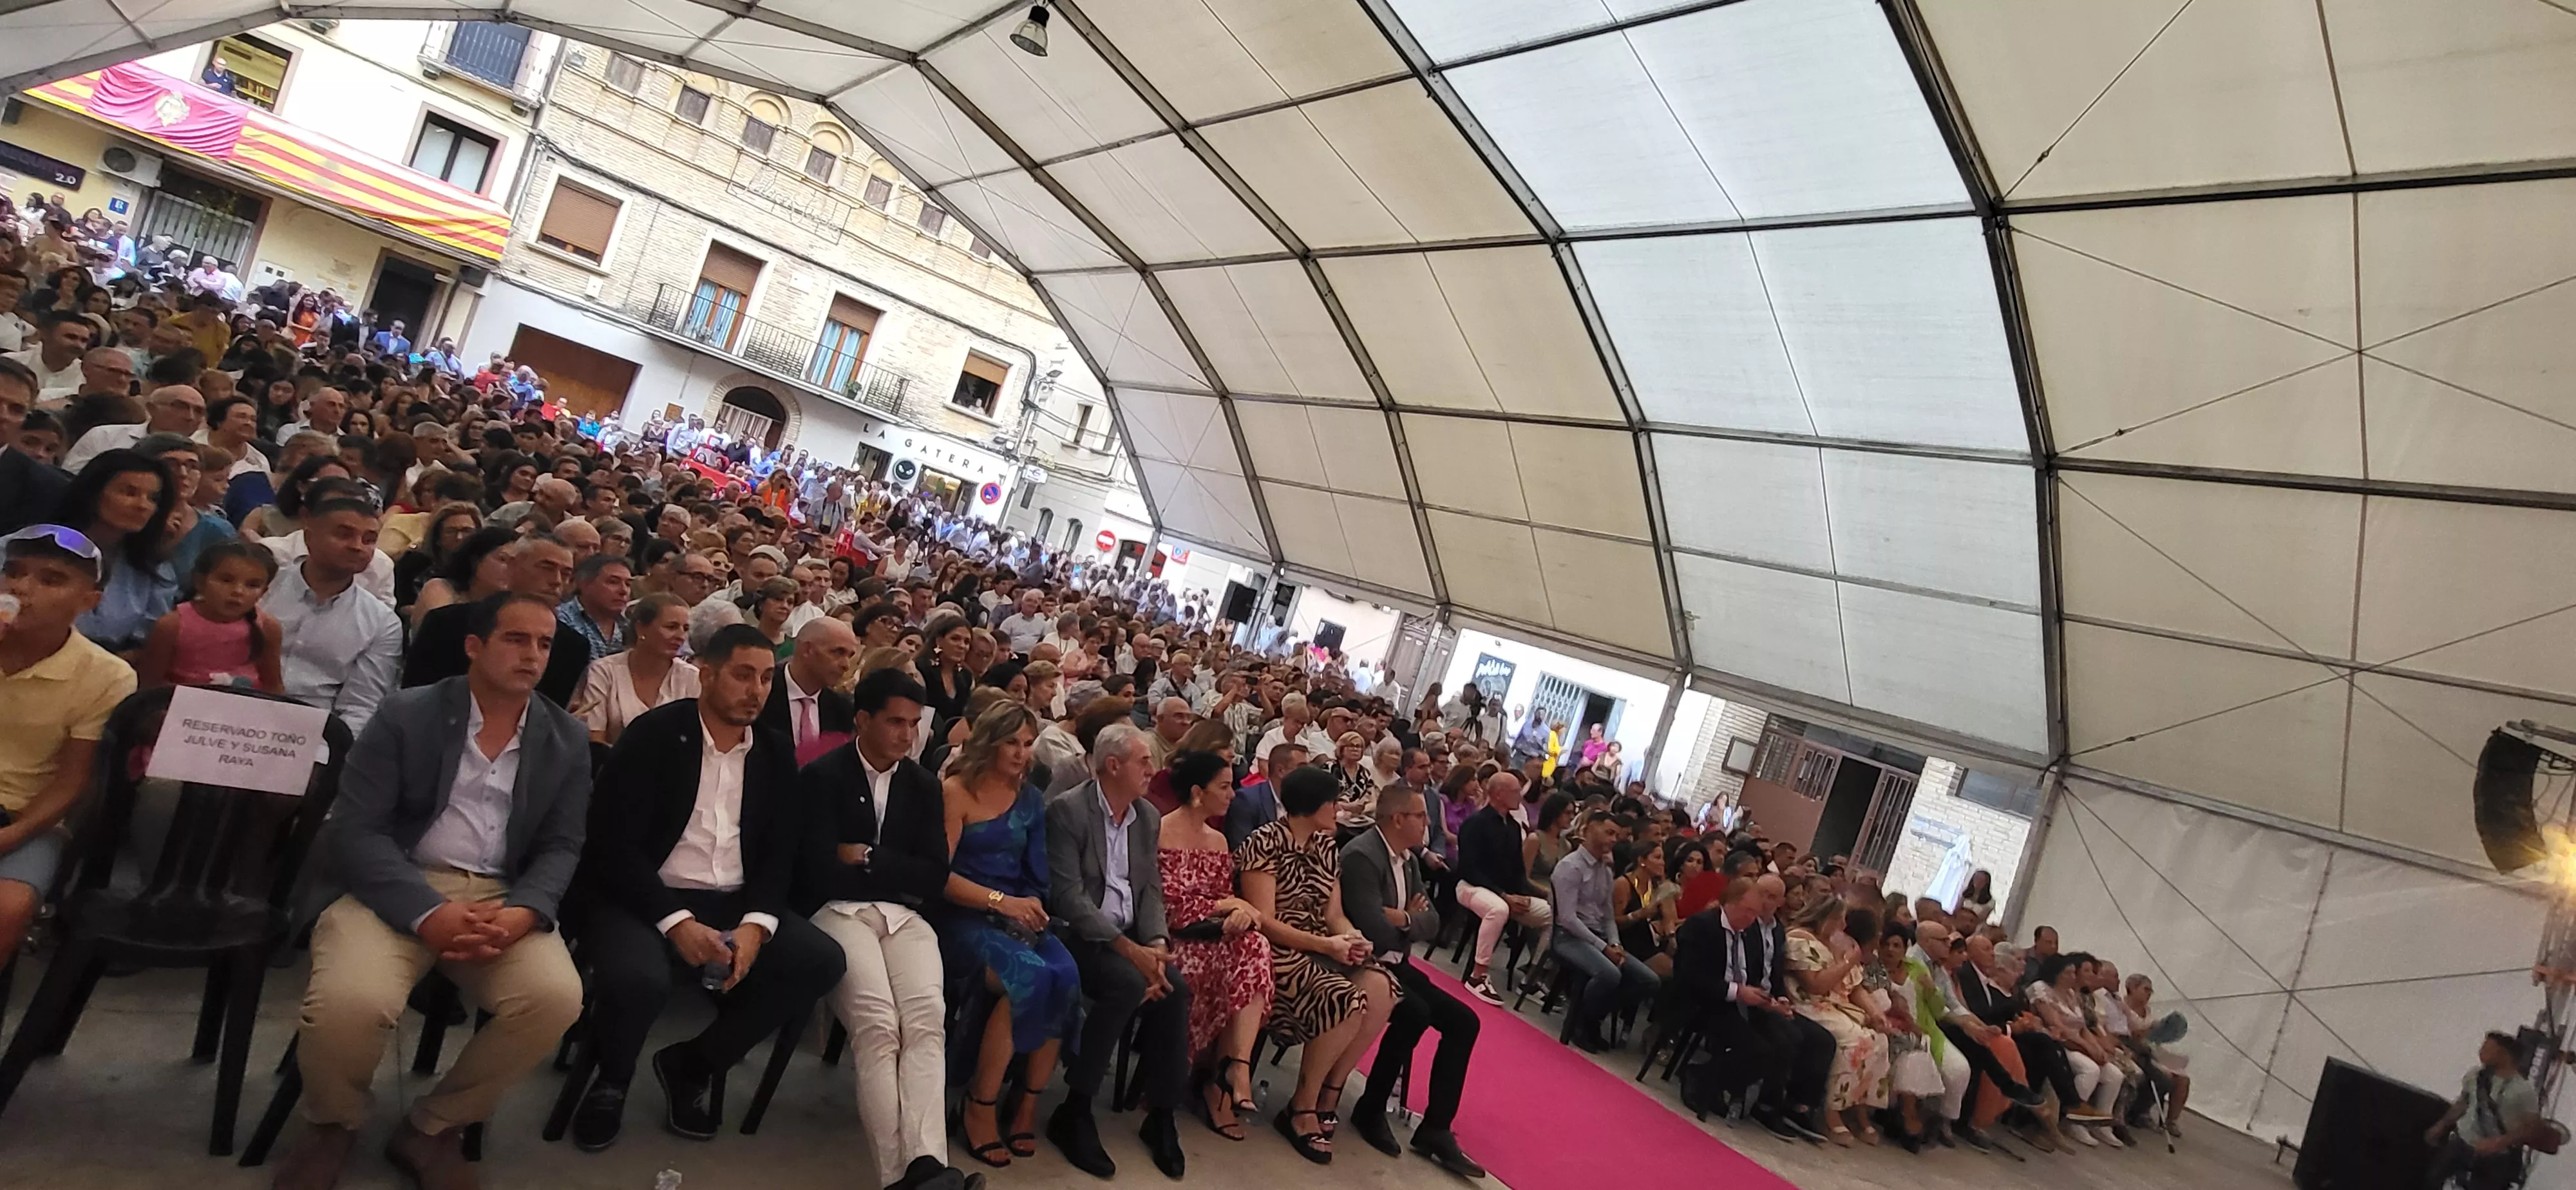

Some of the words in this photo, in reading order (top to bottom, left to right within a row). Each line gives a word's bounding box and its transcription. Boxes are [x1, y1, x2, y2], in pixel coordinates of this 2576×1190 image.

[863, 422, 886, 439] LA
[904, 439, 984, 474] GATERA
[182, 718, 266, 740] RESERVADO
[270, 732, 306, 746] TOÑO
[184, 735, 225, 749] JULVE
[229, 741, 240, 751] Y
[243, 742, 296, 759] SUSANA
[218, 754, 254, 767] RAYA
